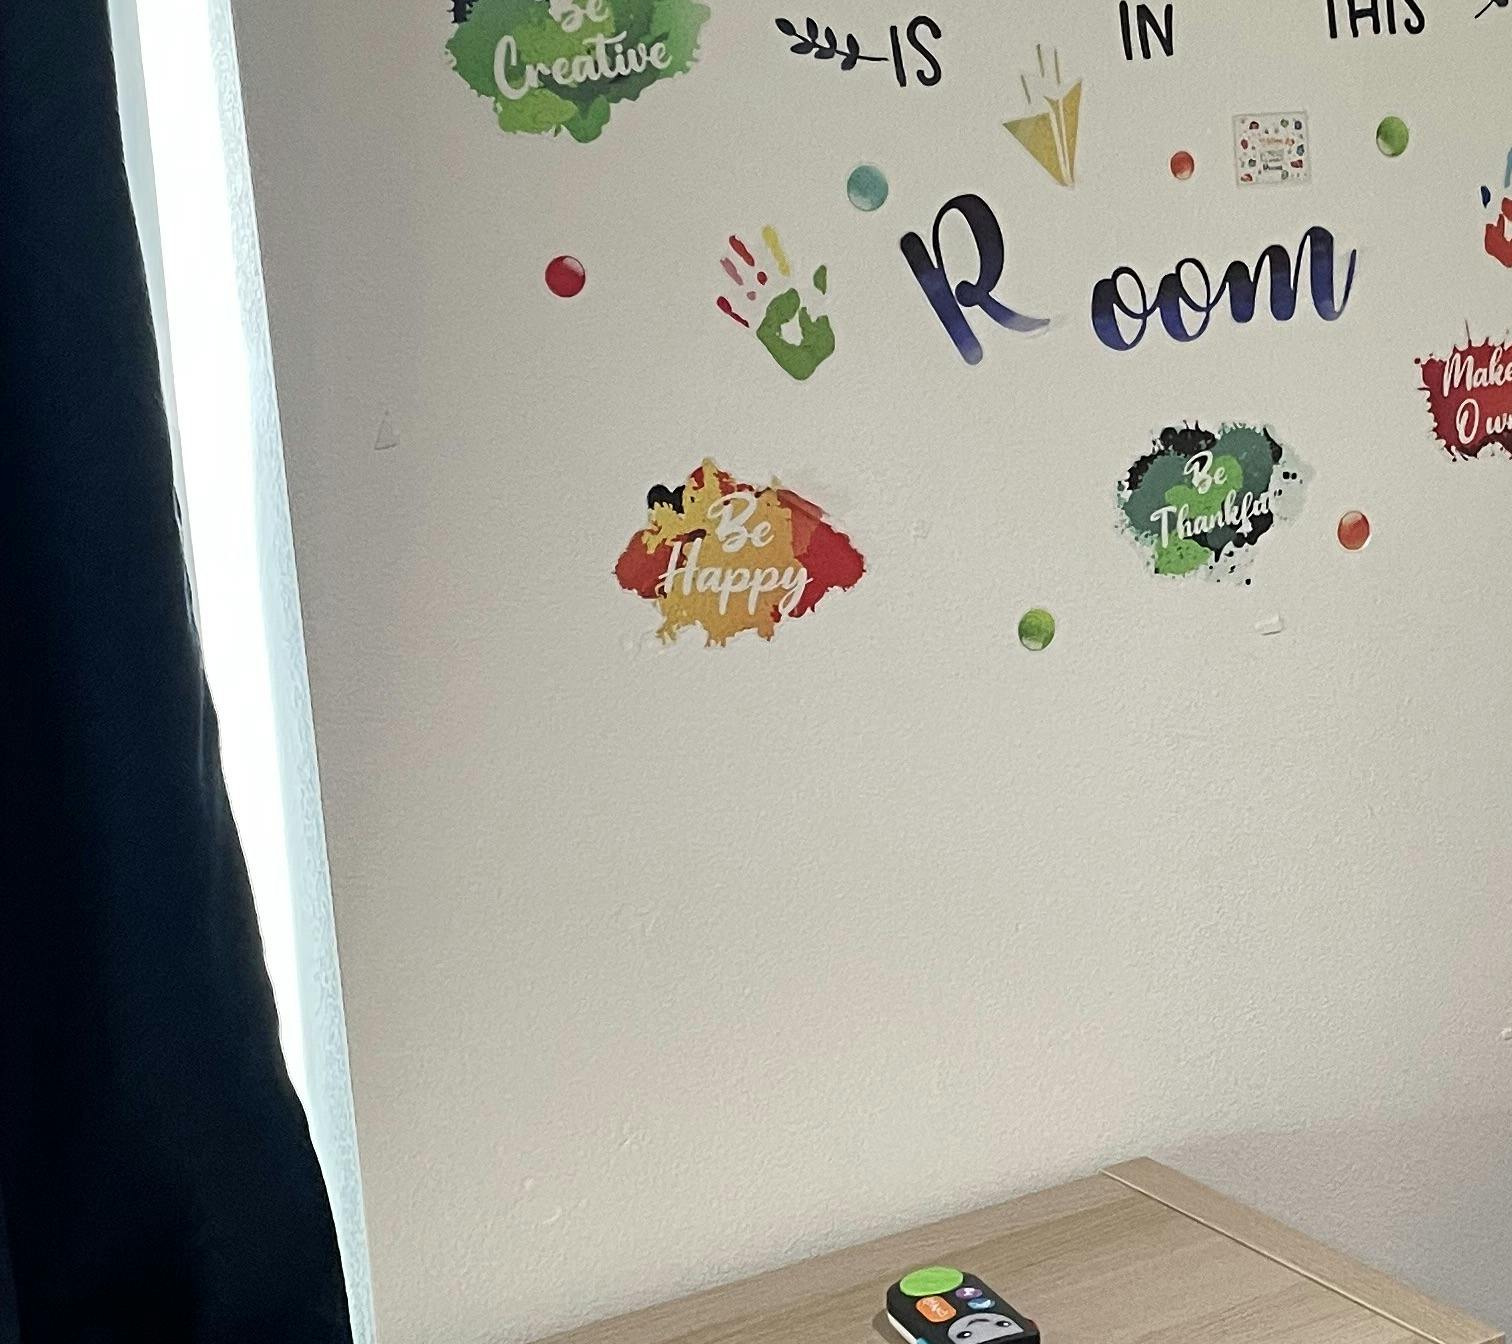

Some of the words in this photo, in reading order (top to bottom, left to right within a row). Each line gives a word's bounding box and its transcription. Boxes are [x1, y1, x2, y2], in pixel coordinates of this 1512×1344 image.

[492, 29, 672, 100] Creative
[888, 15, 943, 88] IS
[1119, 0, 1175, 62] IN
[1183, 450, 1228, 495] Be
[707, 491, 775, 553] Be
[659, 537, 814, 616] Happy
